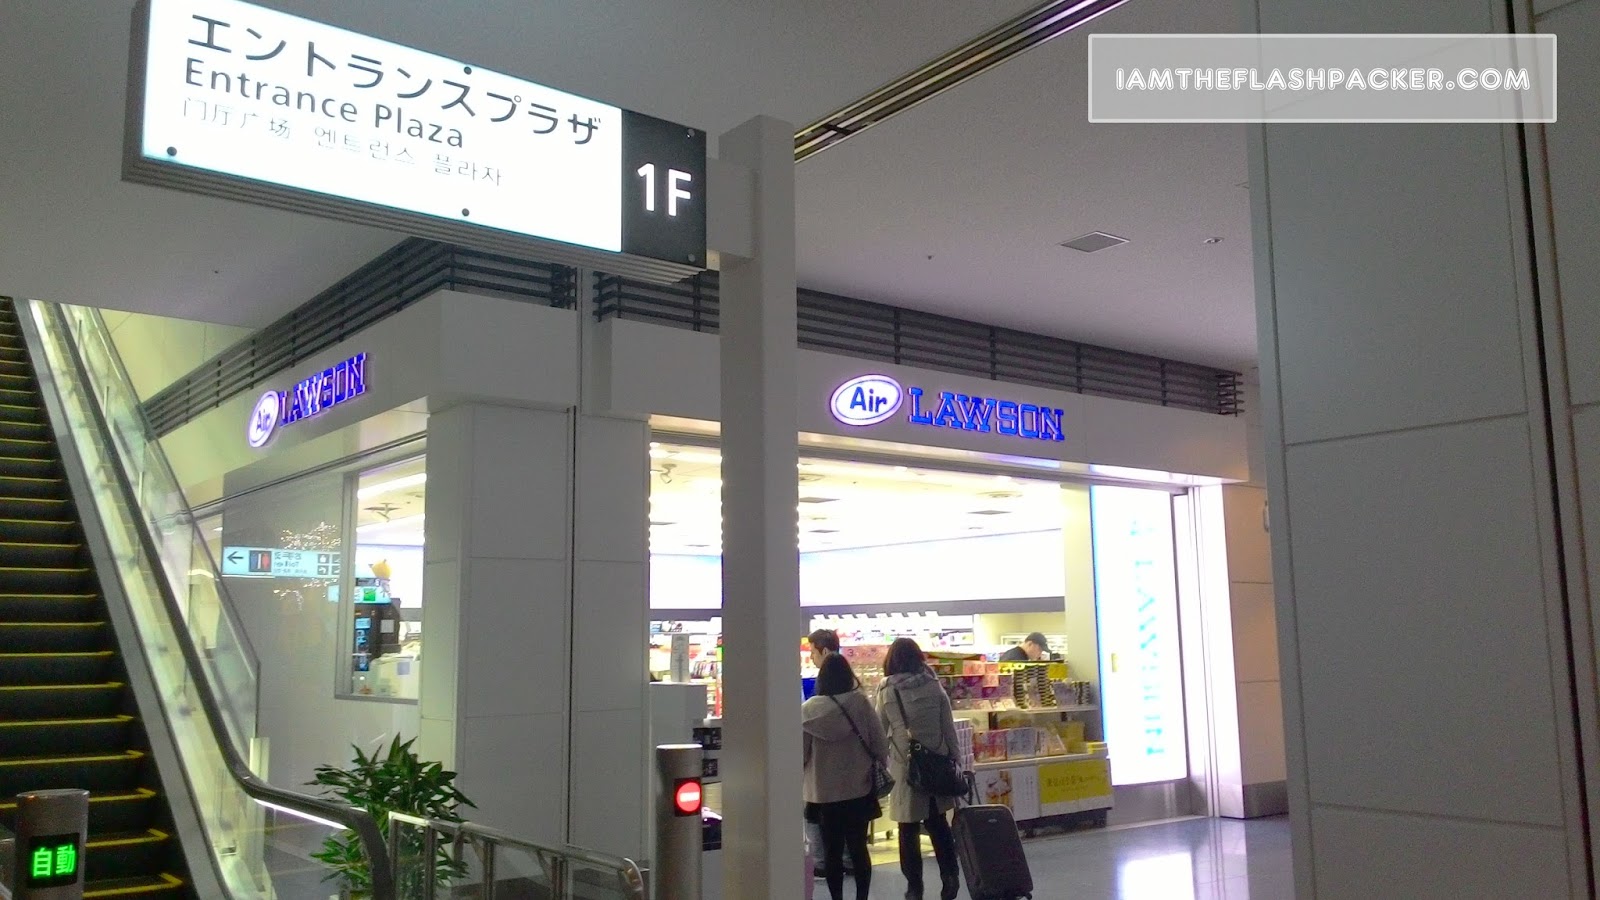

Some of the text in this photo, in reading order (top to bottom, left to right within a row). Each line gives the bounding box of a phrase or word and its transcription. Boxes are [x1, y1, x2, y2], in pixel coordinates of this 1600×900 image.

[185, 57, 463, 148] Entrance Plaza
[188, 13, 602, 145] エントランスプラザ
[637, 163, 692, 217] 1F
[279, 352, 366, 428] LAWSON
[850, 386, 1065, 441] Air LAWSON
[33, 844, 76, 877] 自動
